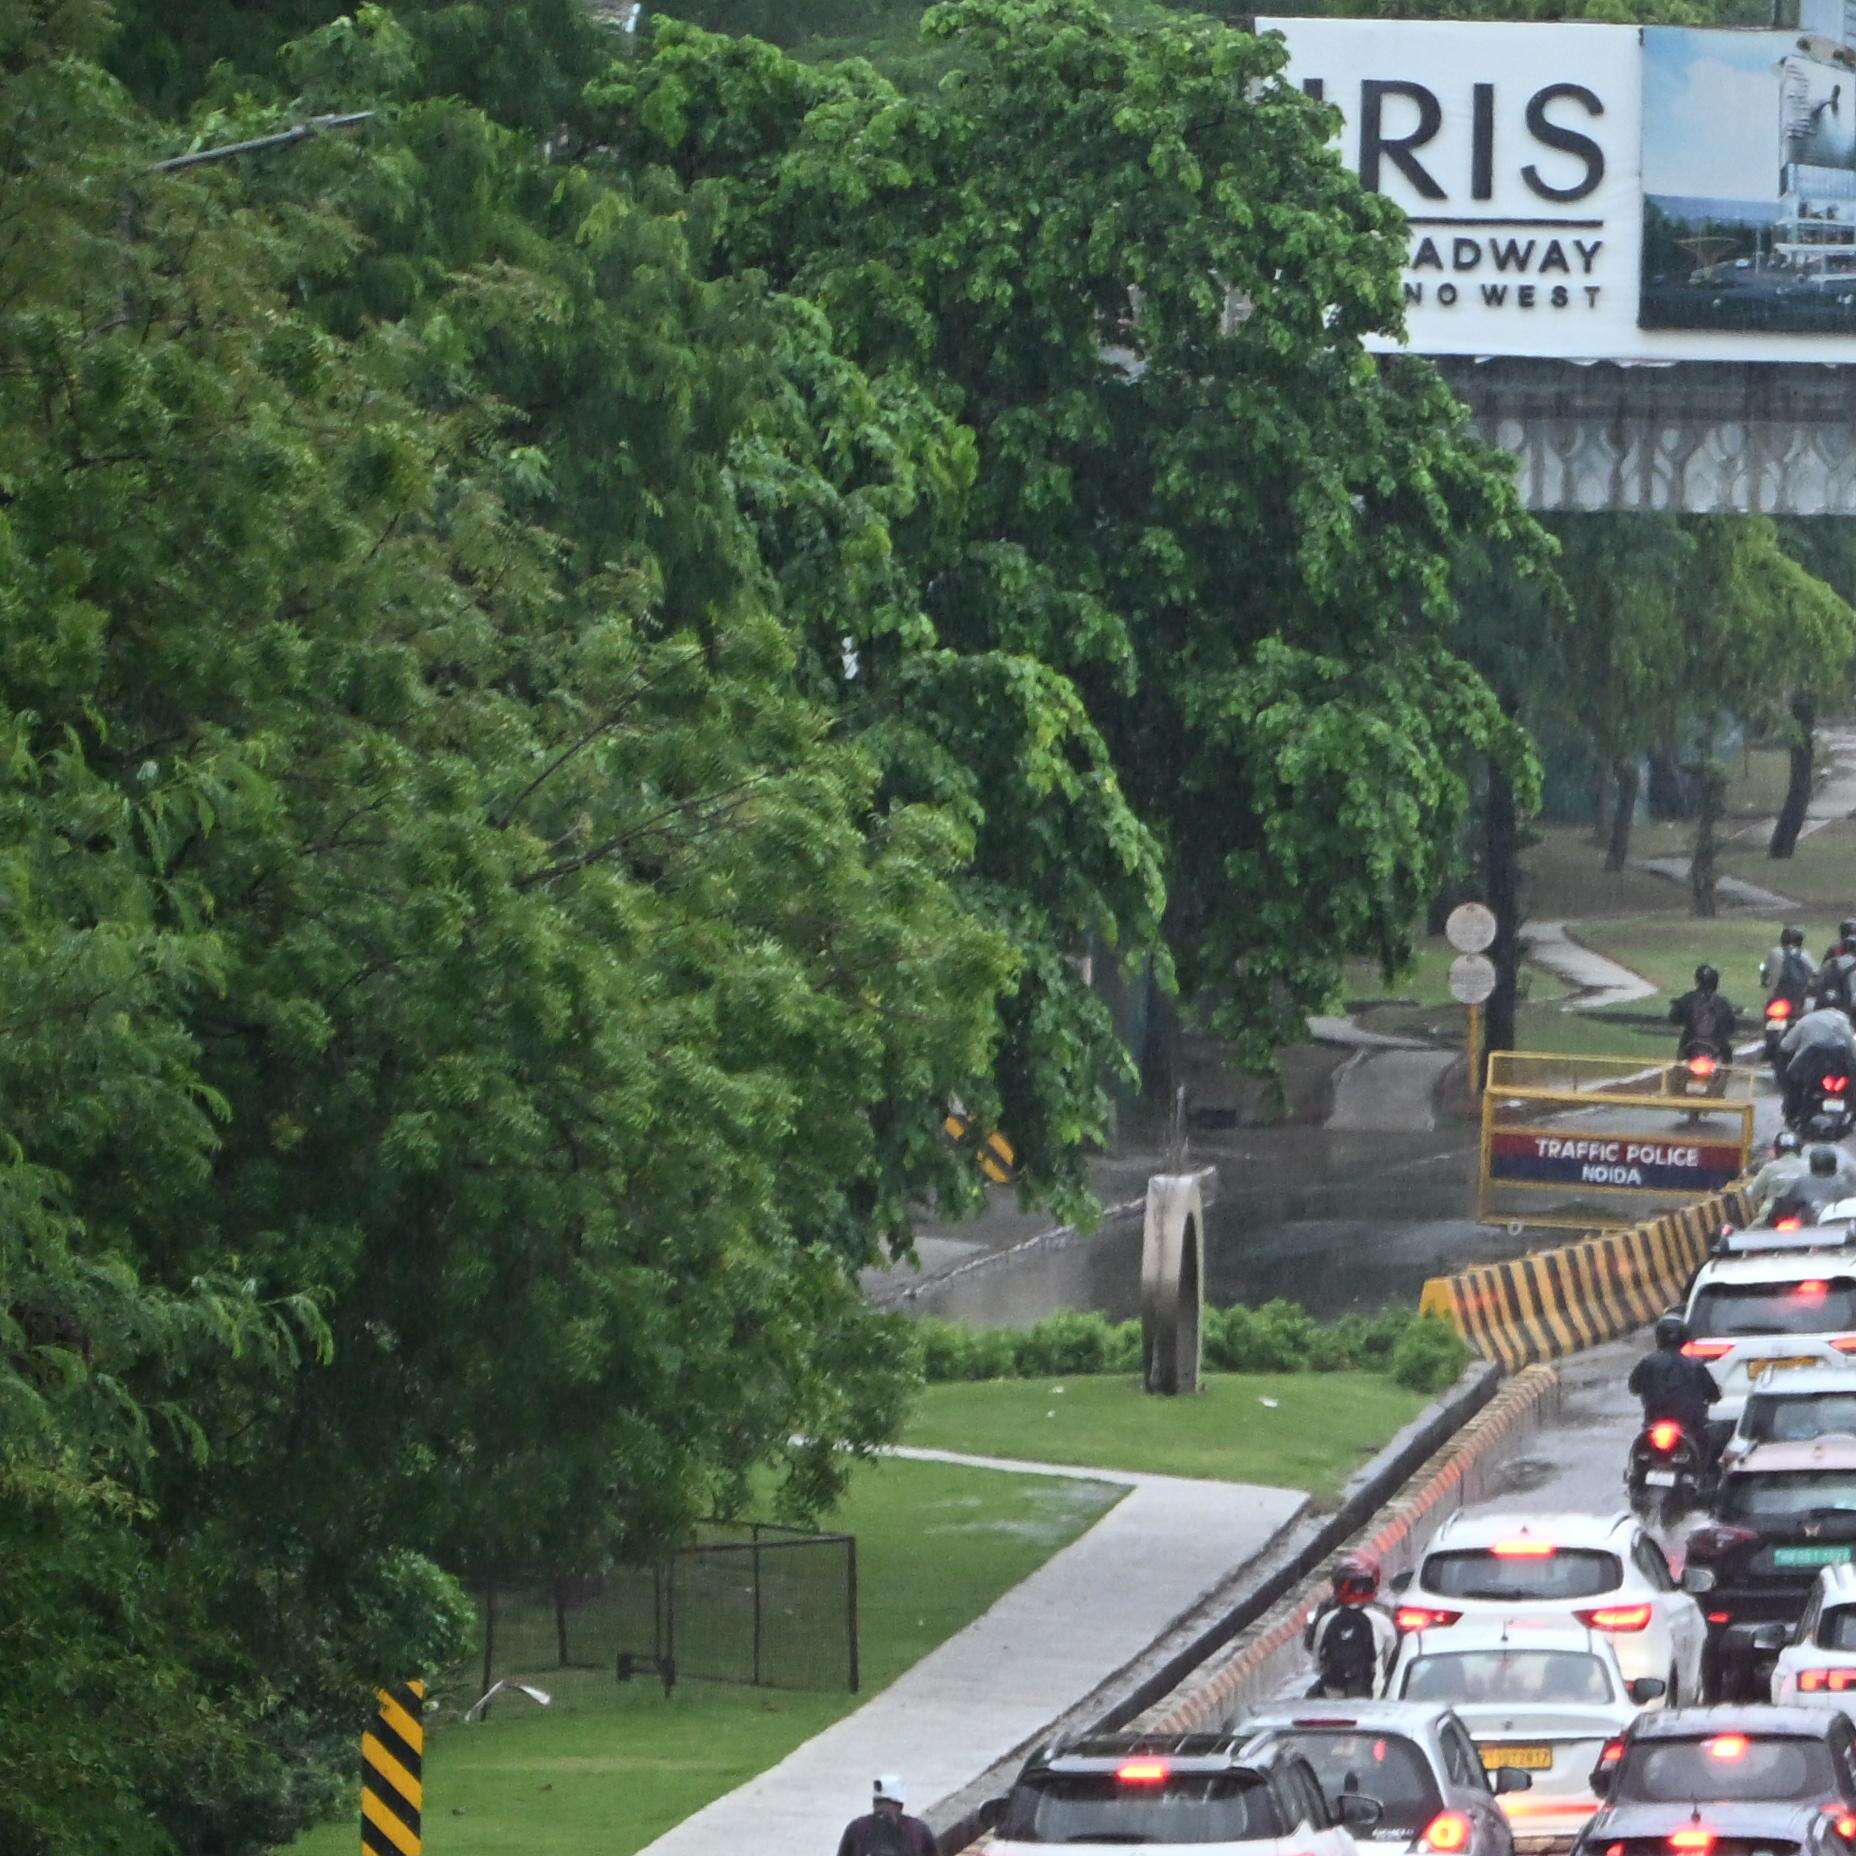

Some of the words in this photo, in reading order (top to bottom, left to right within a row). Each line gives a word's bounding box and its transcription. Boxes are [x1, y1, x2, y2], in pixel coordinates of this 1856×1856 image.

[1481, 284, 1601, 308] WEST
[1535, 1139, 1619, 1164] TRAFFIC
[1626, 1145, 1699, 1168] POLICE
[1581, 1164, 1642, 1186] NOIDA
